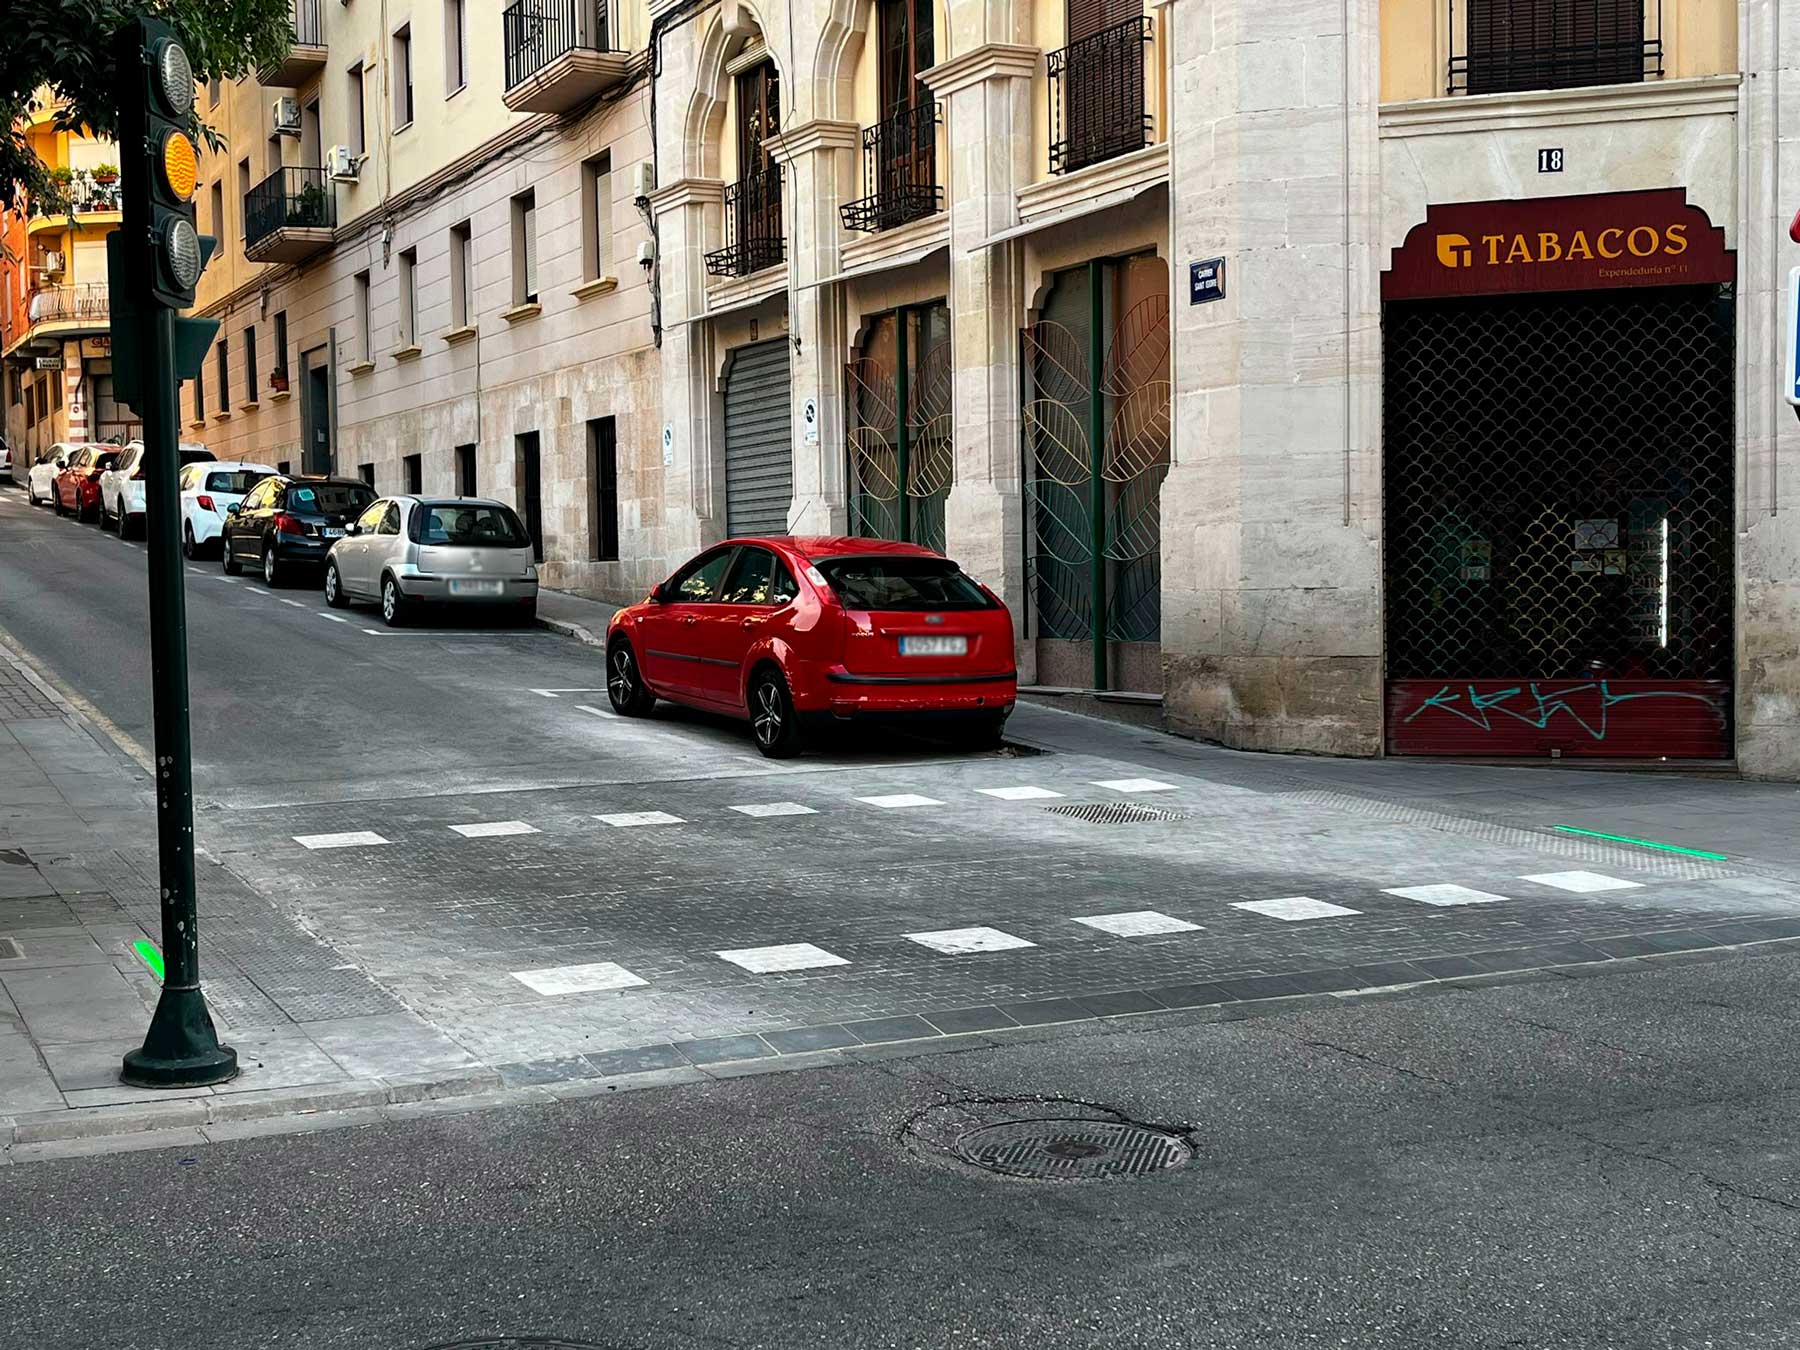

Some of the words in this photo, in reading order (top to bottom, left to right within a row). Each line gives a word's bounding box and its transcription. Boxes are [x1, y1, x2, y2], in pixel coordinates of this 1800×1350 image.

[1541, 150, 1562, 171] 18
[1482, 224, 1688, 264] TABACOS
[1599, 265, 1663, 278] Expendeduría
